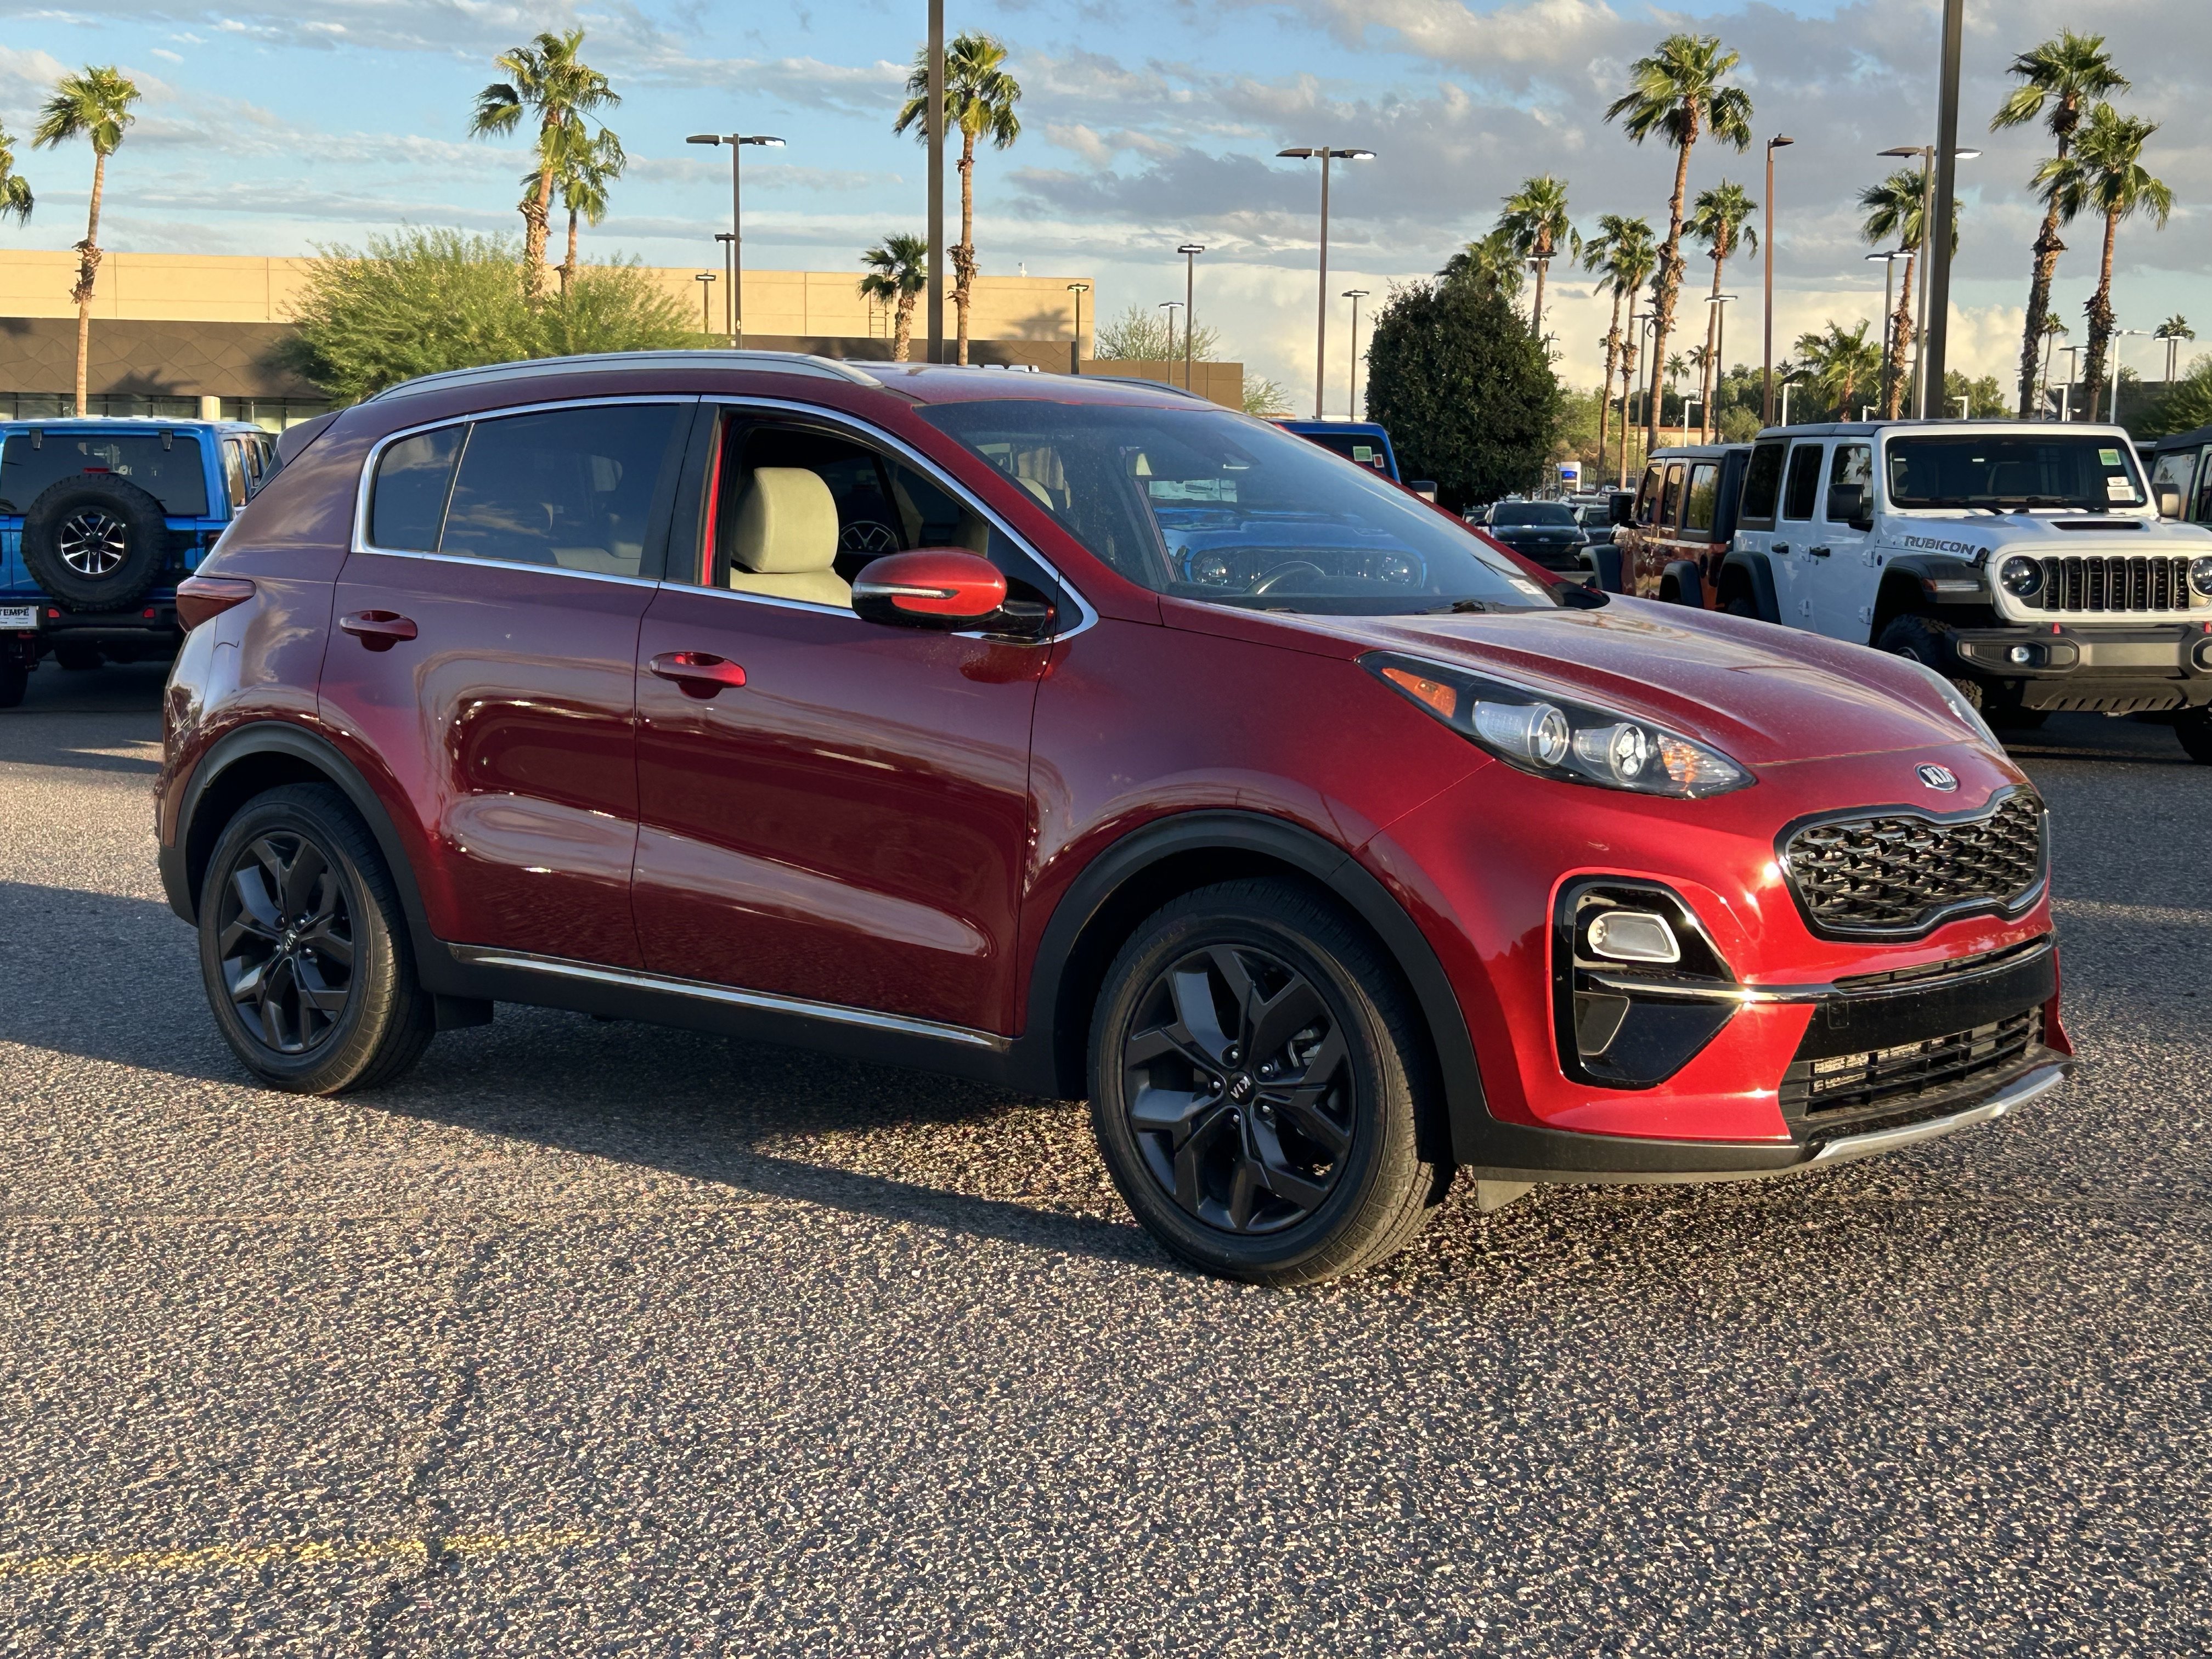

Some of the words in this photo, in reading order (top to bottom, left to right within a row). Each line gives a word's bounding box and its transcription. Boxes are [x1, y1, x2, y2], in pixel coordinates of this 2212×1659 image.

[1904, 535, 1976, 555] RUBICON
[1921, 766, 1956, 785] KIA
[1230, 1076, 1251, 1098] KIA
